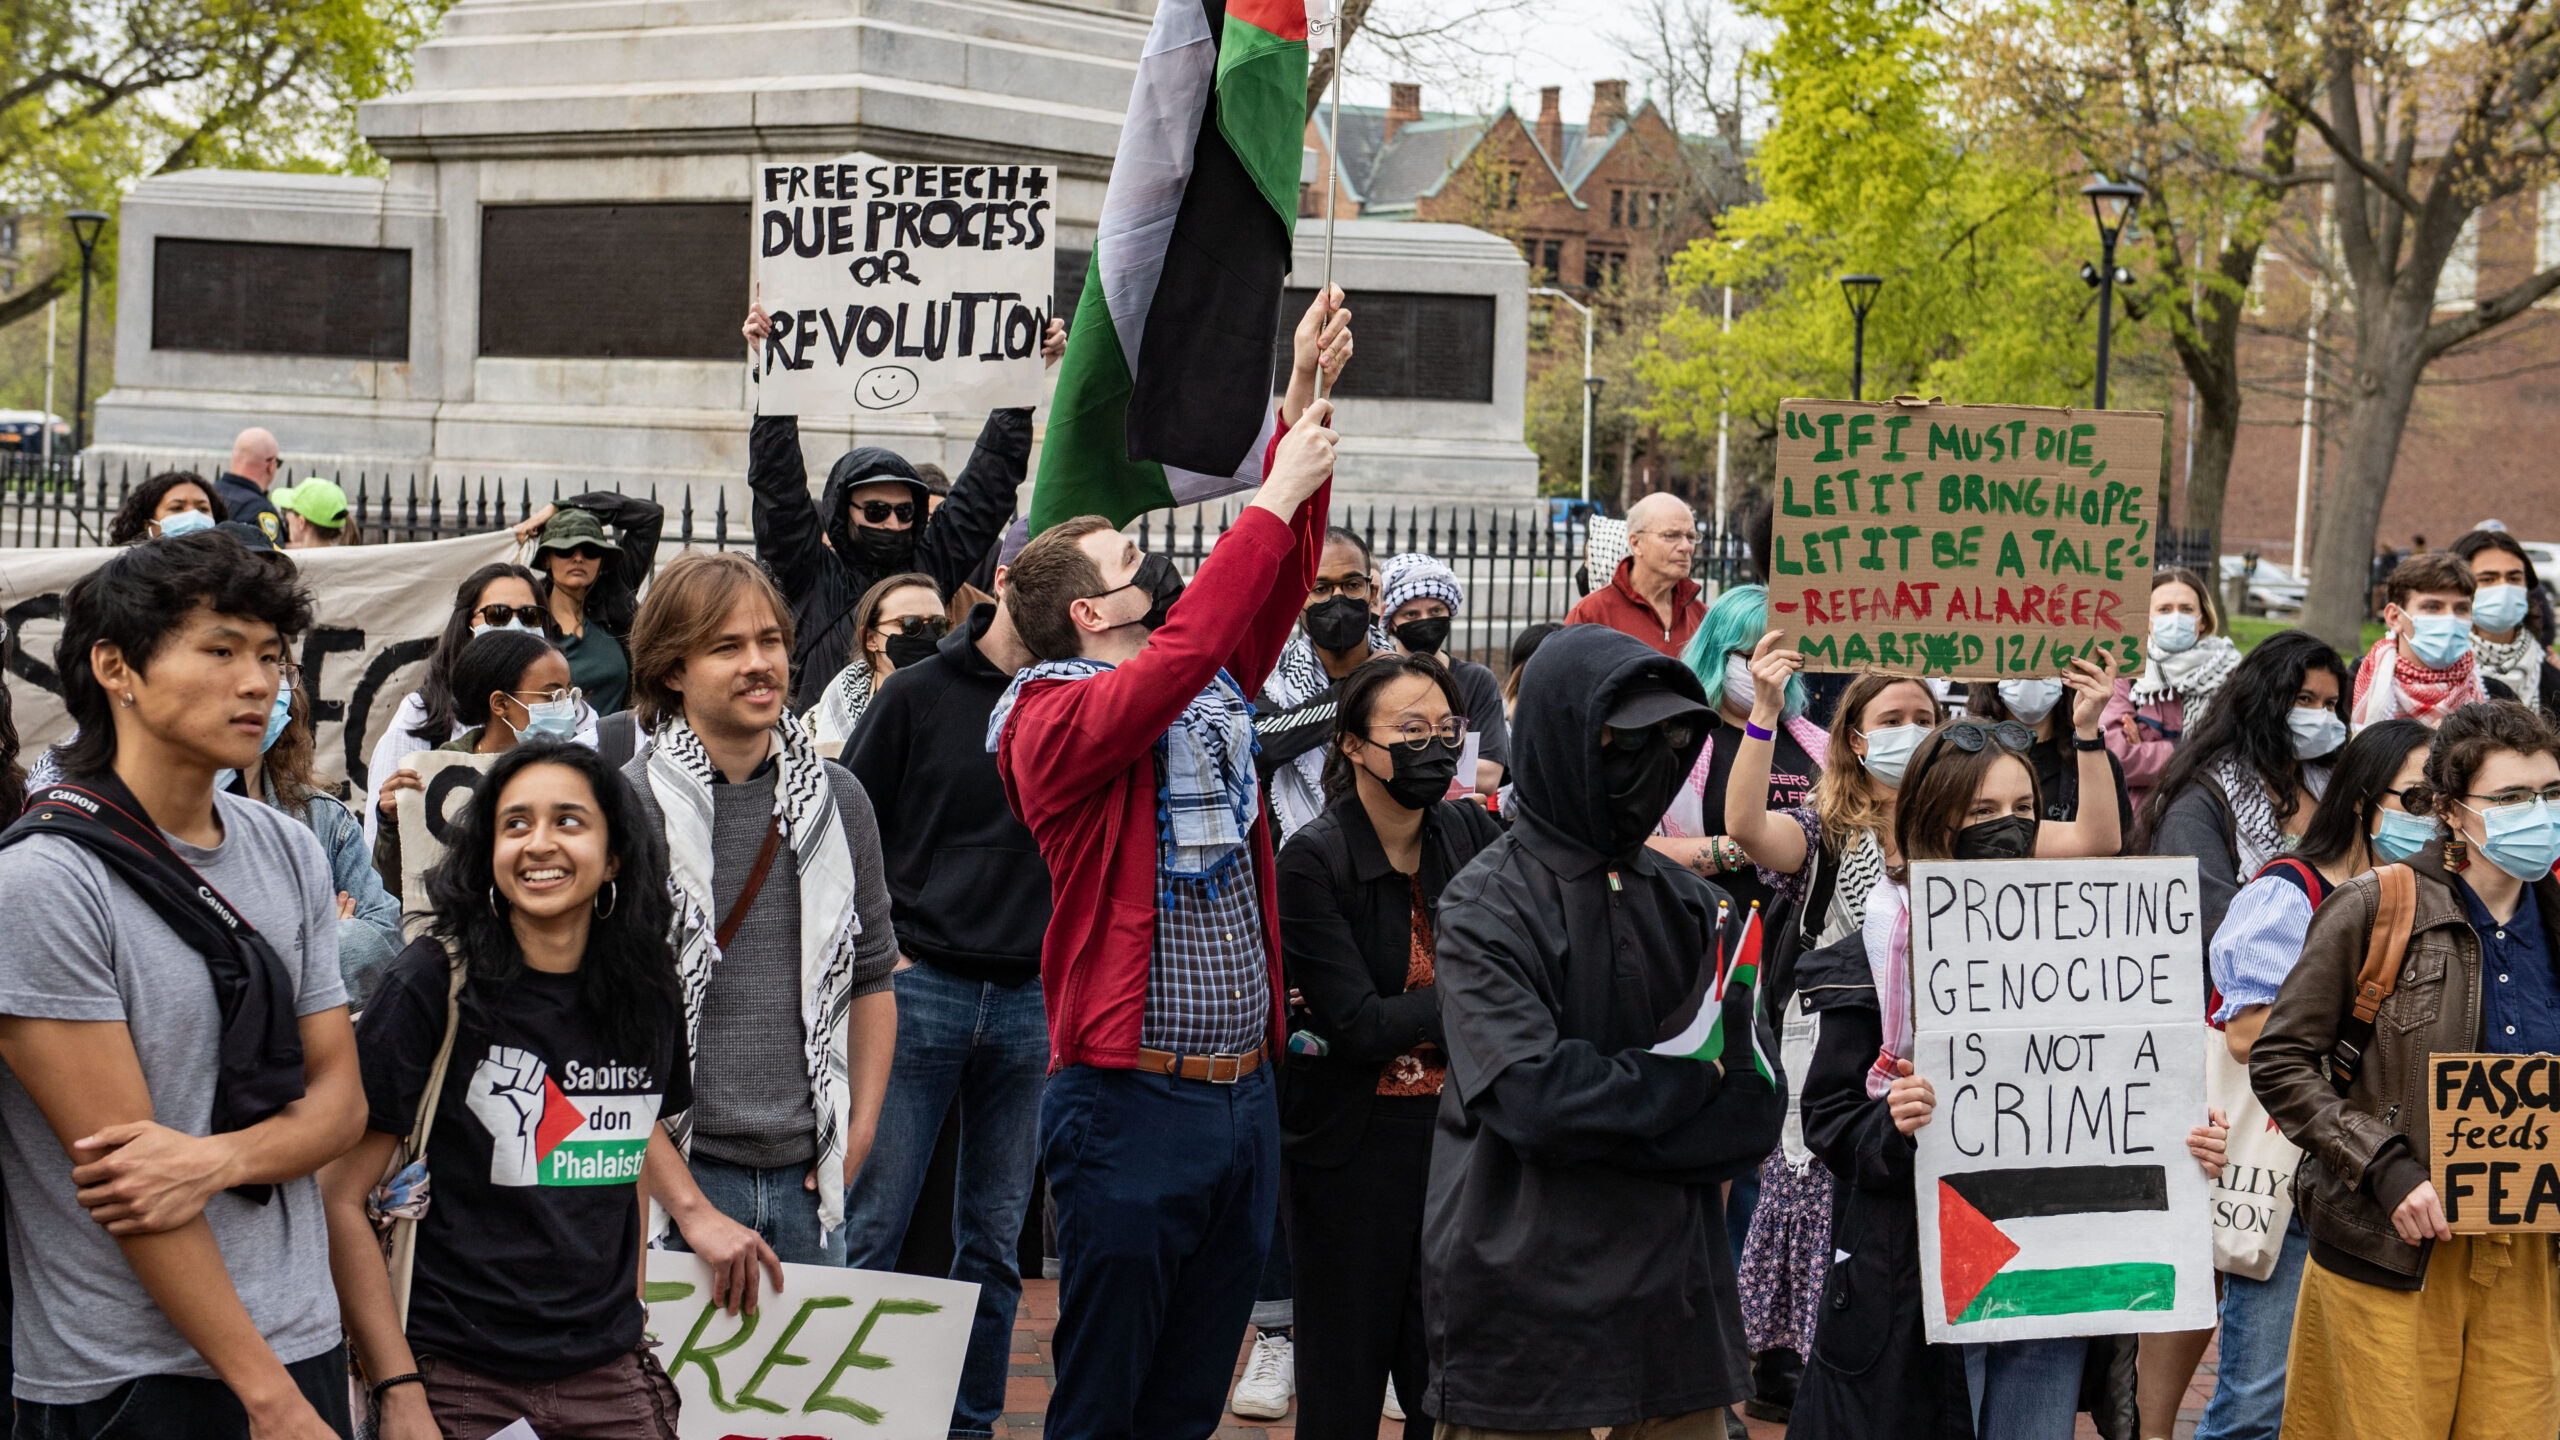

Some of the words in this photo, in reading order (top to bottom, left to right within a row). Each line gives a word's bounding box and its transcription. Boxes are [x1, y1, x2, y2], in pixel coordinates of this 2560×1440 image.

[763, 163, 859, 204] FREE
[762, 205, 855, 258] DUE
[863, 200, 1051, 253] PROCESS
[849, 249, 922, 287] OR
[765, 291, 1053, 376] REVOLUTION
[1881, 414, 1912, 463] I
[1927, 420, 2027, 463] MUST
[1782, 468, 1861, 518] LET
[1868, 471, 1925, 516] IT
[1938, 473, 2049, 517] BRING
[2053, 480, 2151, 541] HOPE,
[1775, 524, 1851, 576] LET
[1858, 524, 1923, 572] IT
[1930, 525, 1985, 570] BE
[1995, 530, 2026, 579] A
[48, 789, 100, 813] Canon
[1772, 789, 1785, 802] A
[197, 885, 239, 929] Canon
[1926, 876, 2195, 951] PROTESTING
[1929, 954, 2173, 1016] GENOCIDE
[1949, 1033, 1987, 1080] IS
[2024, 1033, 2106, 1074] NOT
[2134, 1030, 2160, 1072] A
[589, 1105, 631, 1131] don
[1950, 1082, 2155, 1157] CRIME
[2443, 1113, 2550, 1157] feeds
